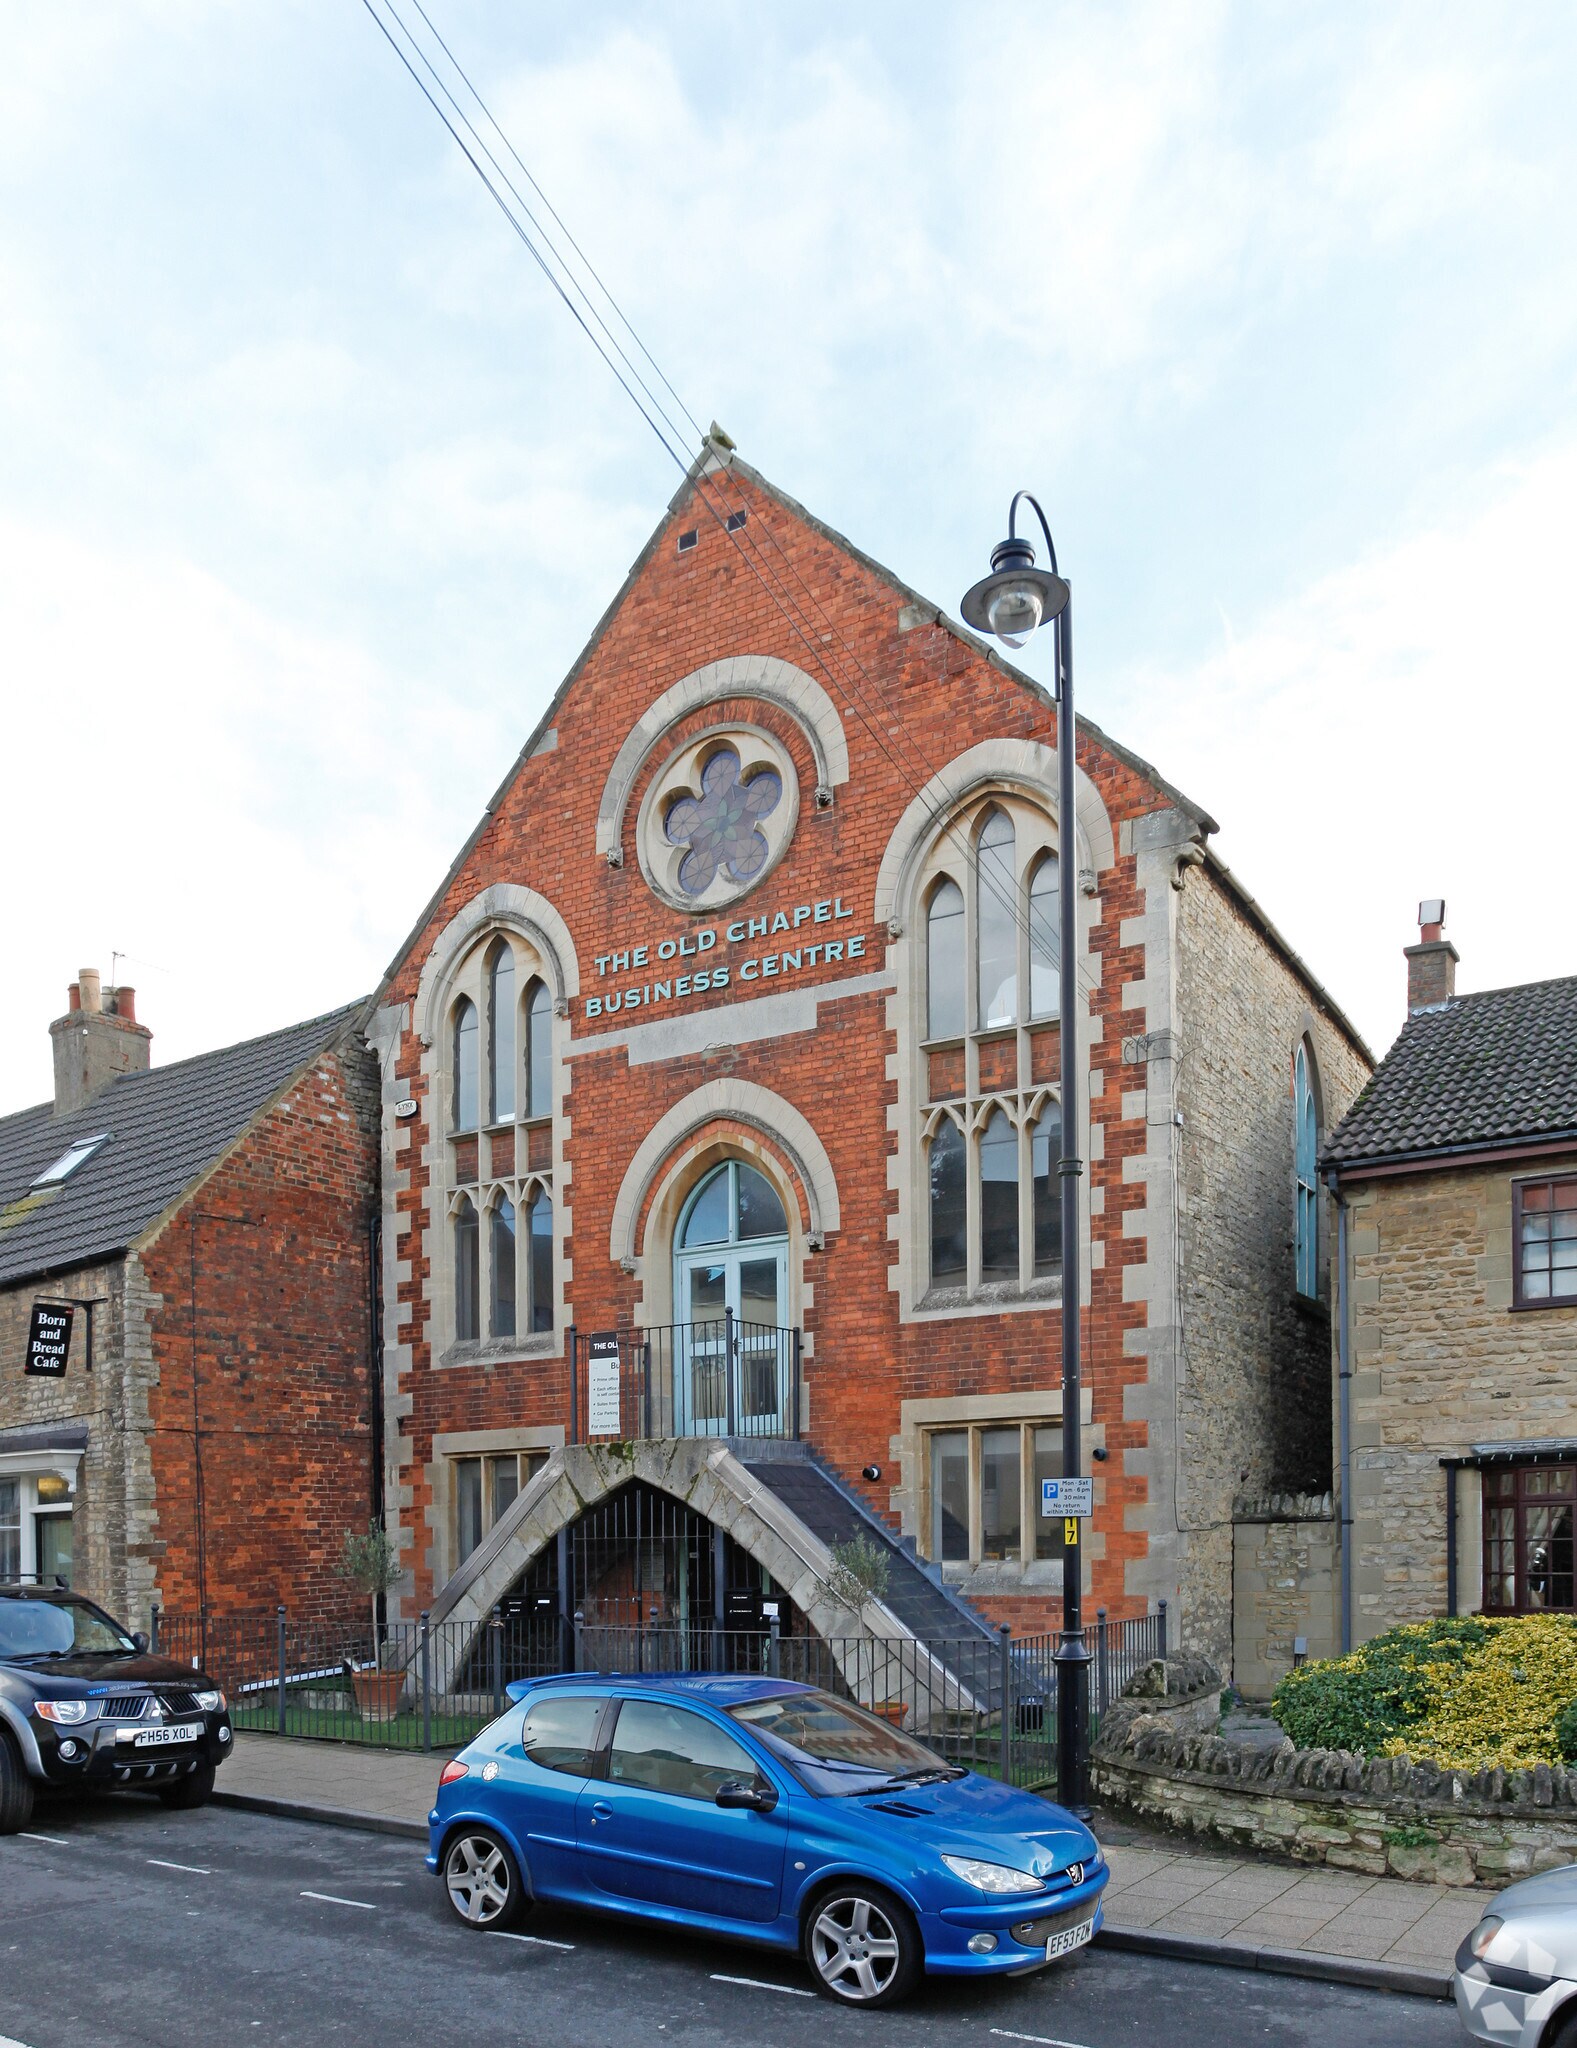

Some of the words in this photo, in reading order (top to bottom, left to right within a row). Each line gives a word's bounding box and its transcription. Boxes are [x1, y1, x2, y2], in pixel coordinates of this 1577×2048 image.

[594, 945, 649, 976] THE
[657, 929, 716, 960] OLD
[726, 897, 854, 943] CHAPEL
[585, 966, 730, 1018] BUSINESS
[739, 934, 867, 981] CENTRE
[38, 1312, 66, 1326] Born
[39, 1329, 61, 1340] and
[31, 1341, 65, 1354] Bread
[593, 1342, 606, 1350] THE
[33, 1356, 60, 1368] Cafe
[1047, 1484, 1057, 1497] P
[1067, 1530, 1076, 1543] 7
[141, 1730, 169, 1743] FH56
[173, 1727, 192, 1739] XOL
[1050, 1930, 1075, 1954] EF53
